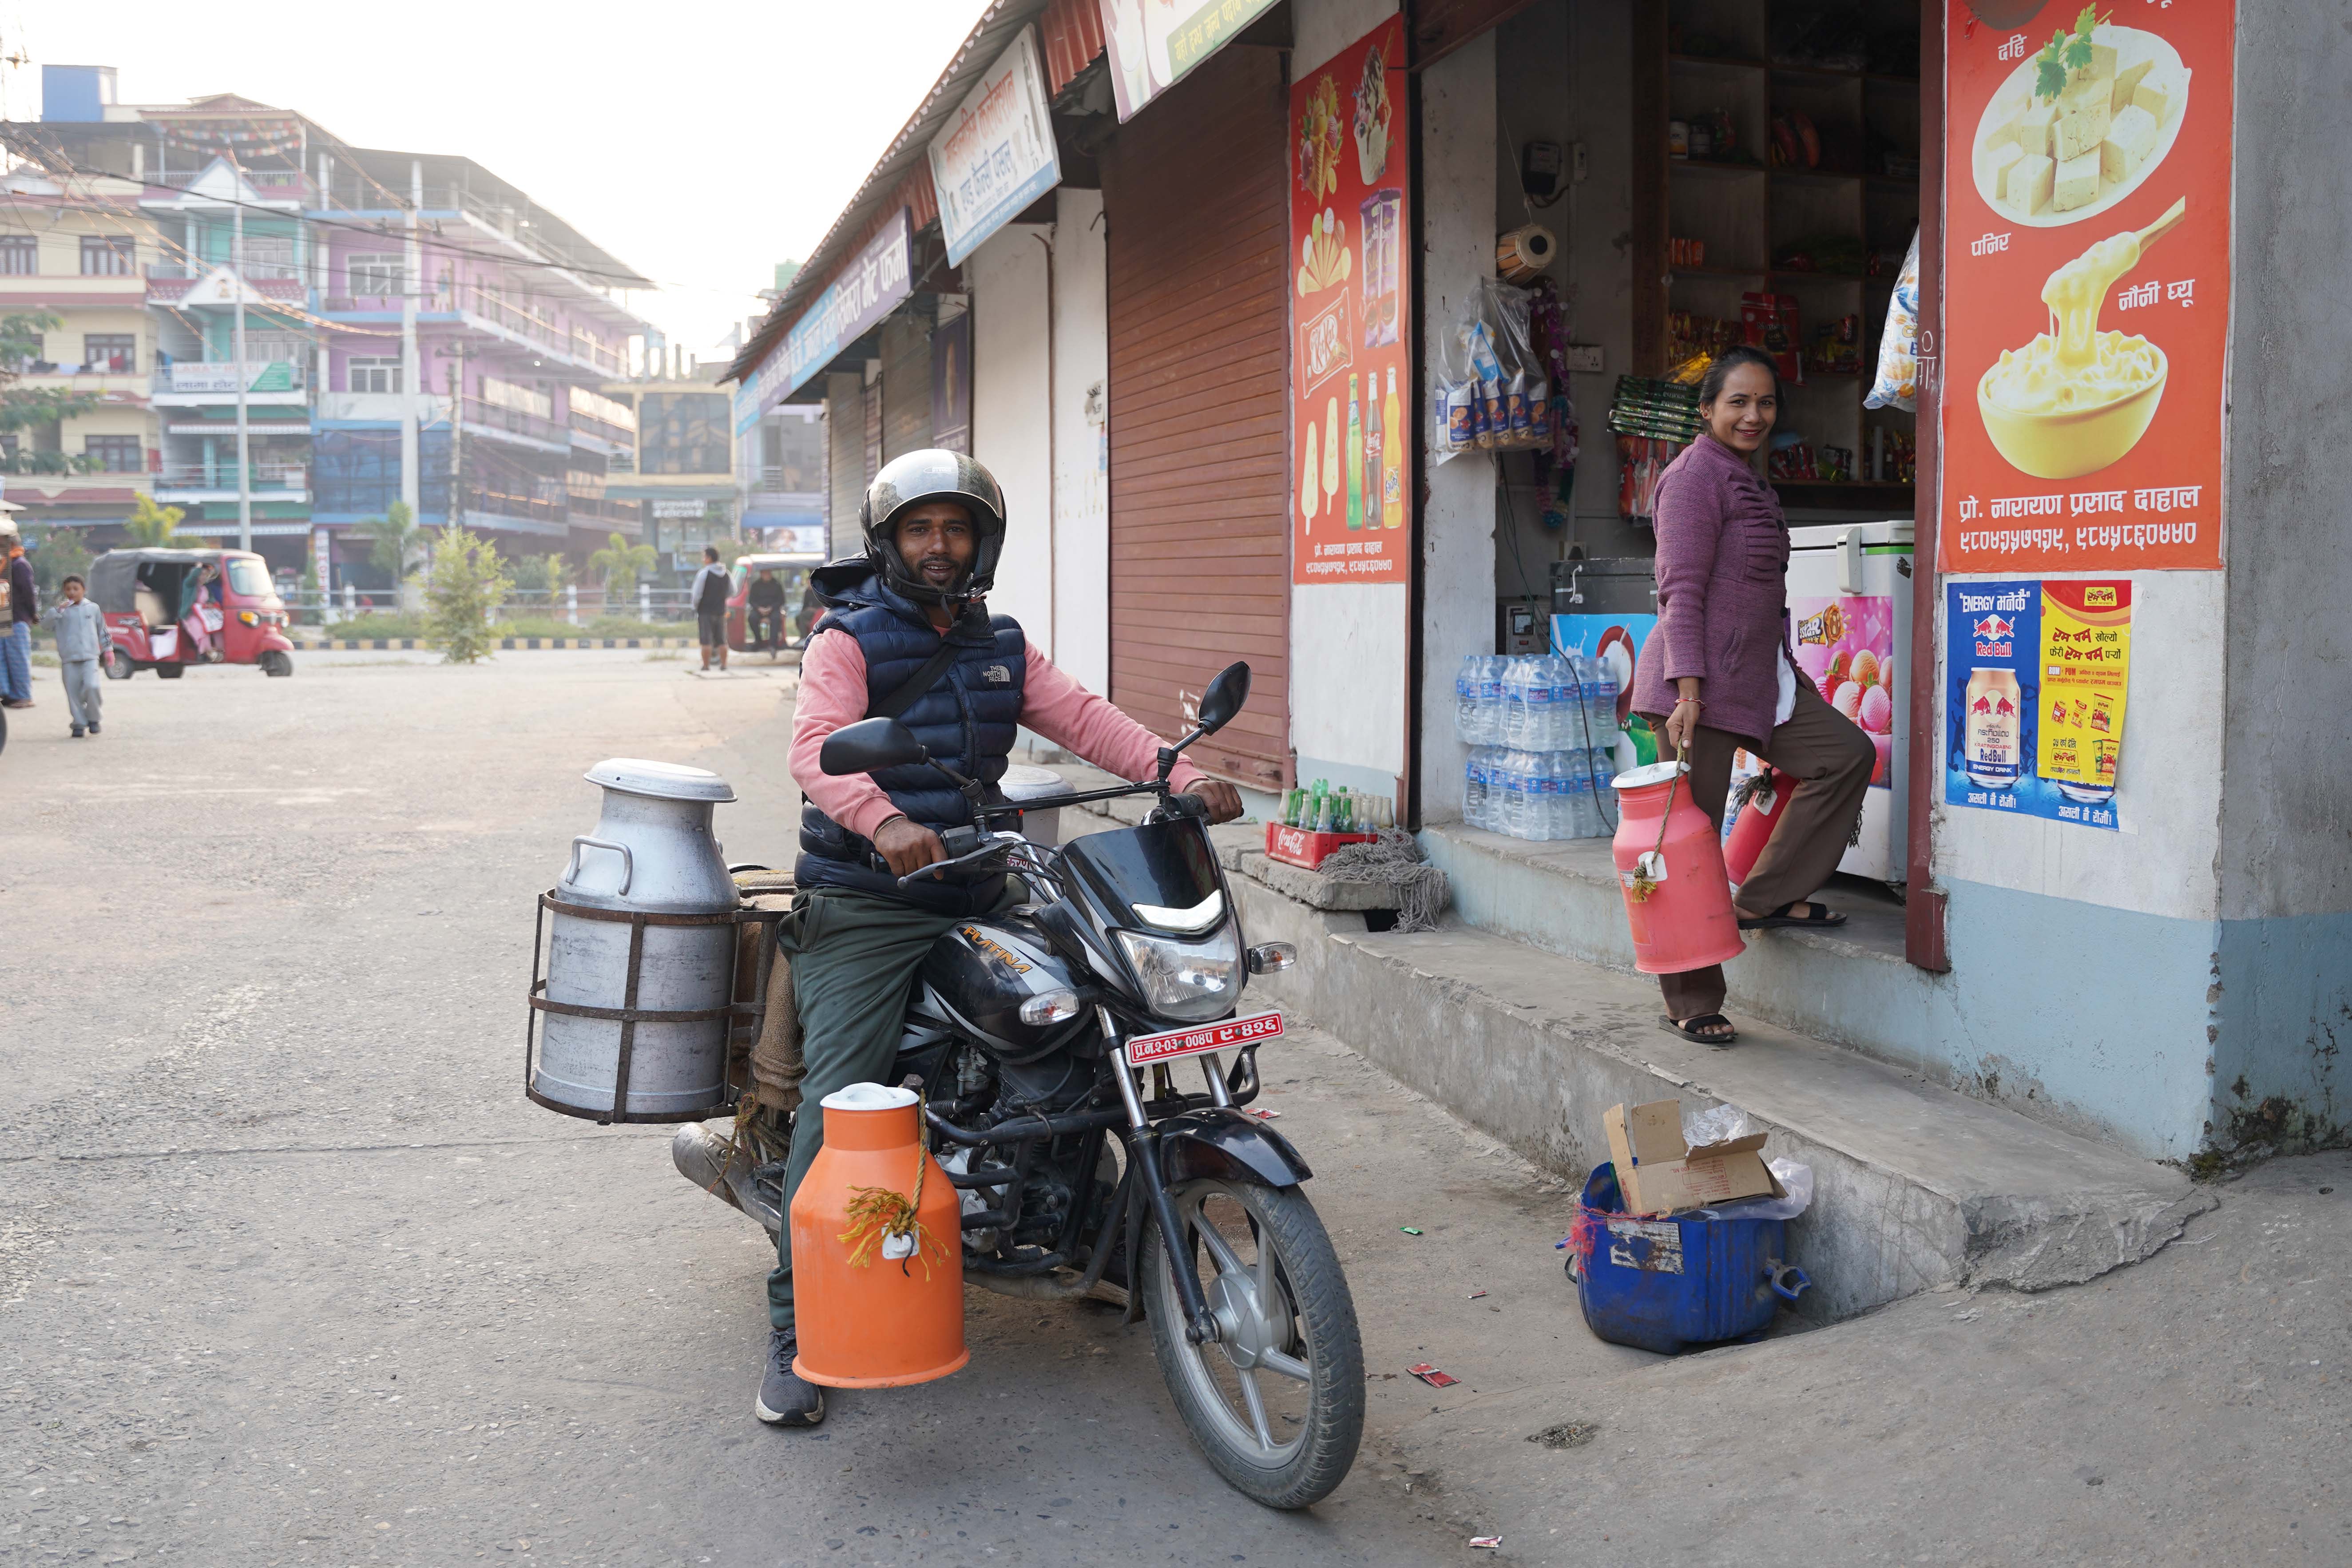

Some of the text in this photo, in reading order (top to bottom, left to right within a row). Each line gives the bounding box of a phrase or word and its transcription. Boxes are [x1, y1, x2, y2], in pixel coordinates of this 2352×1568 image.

[1971, 233, 2011, 257] पनिर
[2118, 280, 2162, 311] नौनी
[1959, 486, 2202, 523] प्रो. नारायण प्रसाद दाहाल
[2053, 627, 2117, 643] रम पम खोल्यो
[1976, 642, 2012, 657] Red Bull
[2050, 646, 2064, 657] फेरी
[2064, 646, 2082, 660] रम
[2085, 647, 2103, 661] पम
[2065, 667, 2076, 676] PUM
[1968, 792, 1987, 805] असली
[1990, 792, 1996, 806] नै
[2058, 806, 2080, 820] असली
[2083, 807, 2090, 821] नै
[963, 925, 1033, 974] PLATINA
